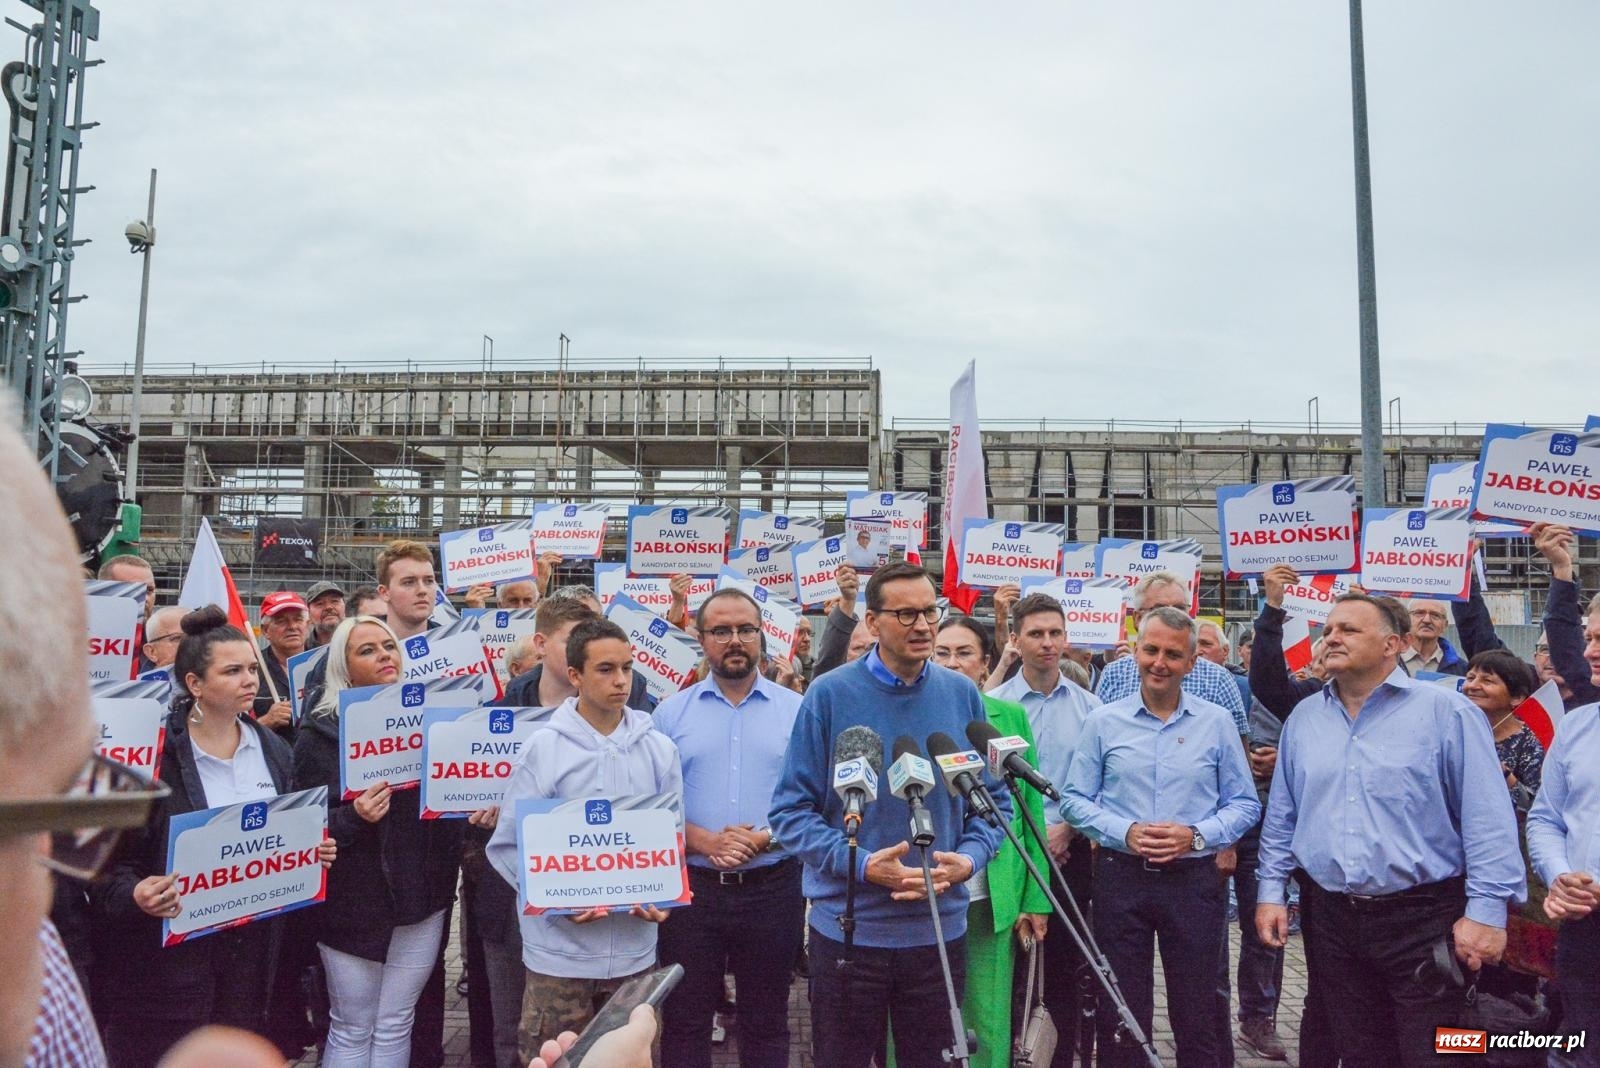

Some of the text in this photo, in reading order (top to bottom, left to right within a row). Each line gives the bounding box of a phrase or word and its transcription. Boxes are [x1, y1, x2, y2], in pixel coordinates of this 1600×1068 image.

[1527, 460, 1593, 478] PAWEŁ
[1485, 472, 1600, 500] JABŁOŃS
[871, 509, 903, 517] PAWEŁ
[1259, 511, 1315, 524] PAWEŁ
[1493, 501, 1600, 521] KANDYDAT DO SEJM
[553, 520, 583, 528] PAWEŁ
[532, 528, 600, 539] JABŁOŃSKI
[659, 529, 699, 539] PAWEŁ
[1230, 523, 1350, 546] JABŁOŃSKI
[279, 537, 313, 546] TEXOM
[634, 540, 721, 554] JABŁOŃSKI
[992, 542, 1032, 553] PAWEŁ
[1393, 537, 1438, 547] PAWEŁ
[470, 543, 507, 555] PAWEŁ
[448, 549, 530, 571] JABŁOŃSKI
[819, 555, 847, 568] PAWE
[878, 556, 886, 566] 5
[966, 553, 1055, 570] JABŁOŃSKI
[1242, 554, 1338, 565] KANDYDAT DO SEJMU!
[1366, 549, 1464, 568] JABŁOŃSKI
[747, 565, 779, 575] PAWEŁ
[623, 583, 660, 591] PAWEŁ
[1372, 576, 1410, 584] KANDYDAT
[1411, 577, 1422, 585] DO
[1060, 599, 1094, 608] AWEŁ
[1067, 609, 1119, 623] OŃSKI
[630, 630, 668, 658] PAWEŁ
[631, 644, 683, 685] OŃSKI
[386, 714, 423, 730] PAW
[349, 733, 423, 760] JABŁO
[471, 742, 522, 755] PAWE
[363, 763, 422, 780] KANDYDAT D
[431, 761, 512, 779] JABŁO
[444, 793, 499, 801] KANDYDAT
[569, 832, 636, 847] PAWEŁ
[221, 834, 286, 860] PAWEŁ
[529, 848, 676, 873] JABŁOŃSKI
[178, 847, 321, 897] JABŁOŃSKI
[545, 883, 664, 897] KANDYDAT DO SEJMU!
[190, 882, 305, 920] KANDYDAT DO SEJMU!
